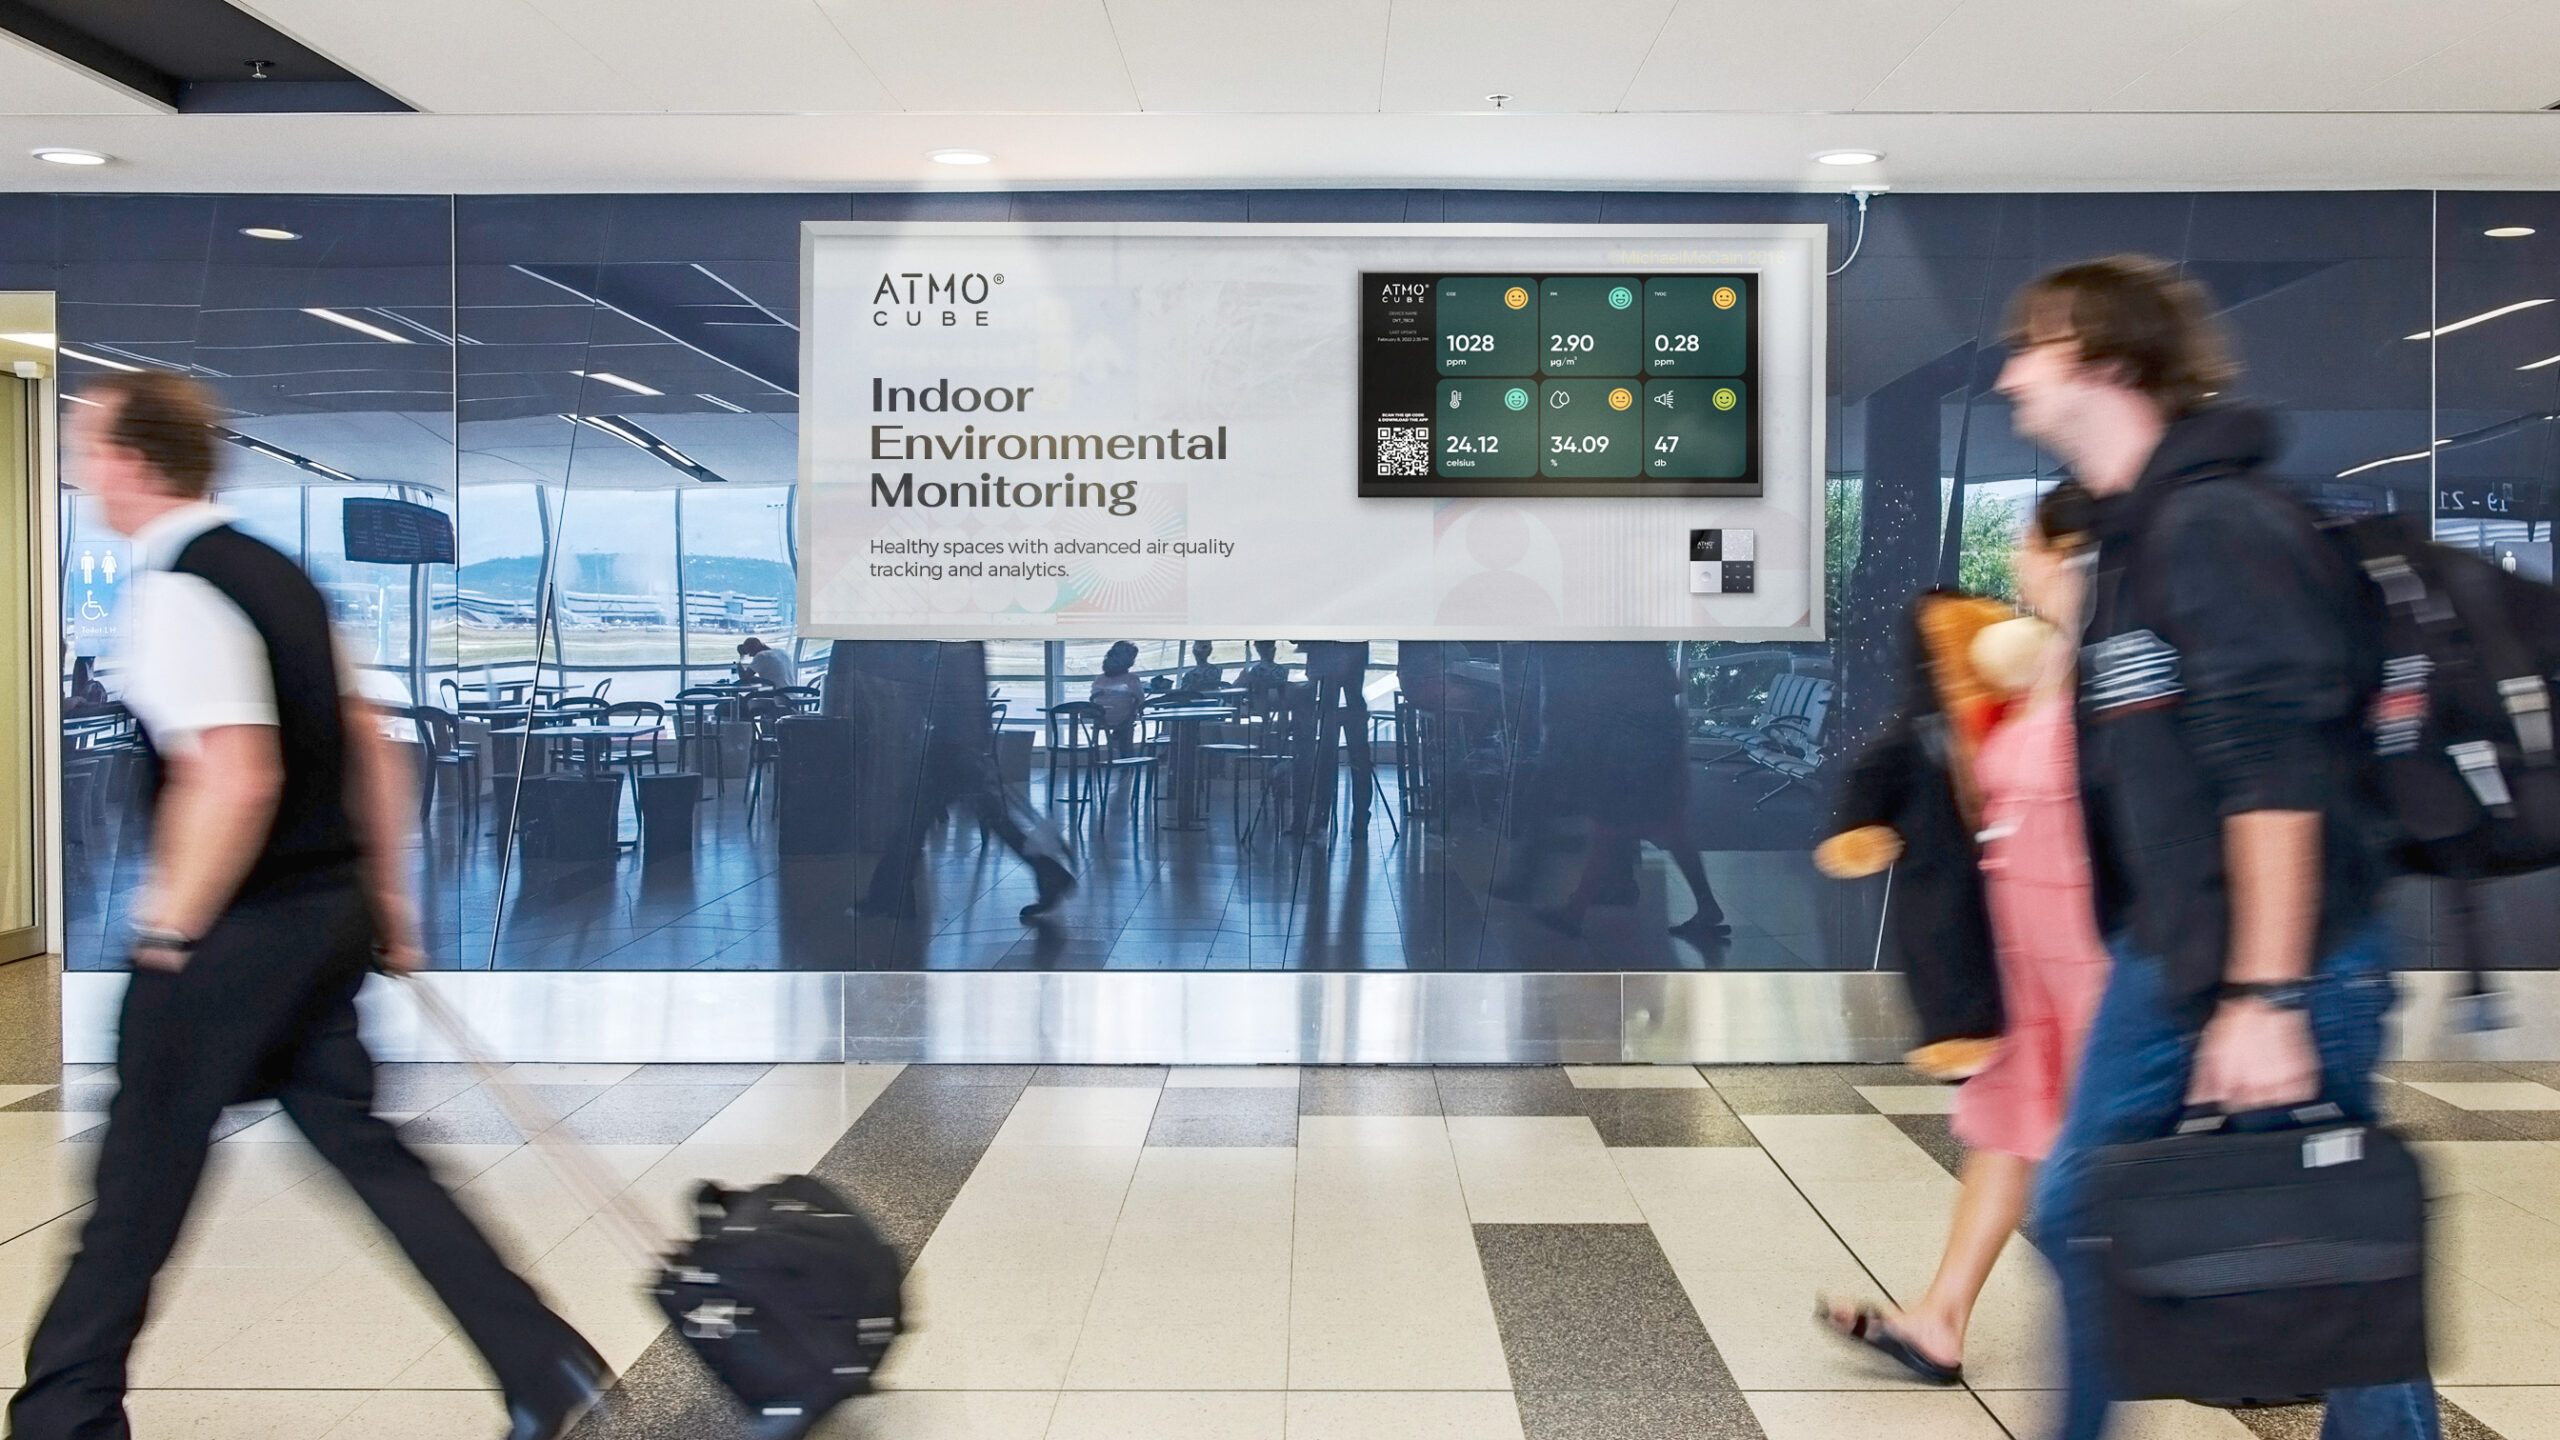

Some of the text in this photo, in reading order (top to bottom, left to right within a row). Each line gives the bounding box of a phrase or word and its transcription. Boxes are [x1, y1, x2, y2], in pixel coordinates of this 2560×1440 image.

[873, 311, 989, 326] CUBE
[1446, 334, 1495, 352] 1028
[1550, 334, 1594, 352] 2.90
[1655, 334, 1700, 352] 0.28
[1446, 359, 1467, 367] ppm
[1654, 359, 1675, 367] ppm
[873, 378, 1034, 412] Indoor
[872, 425, 1227, 460] Environmental
[1446, 435, 1499, 453] 24.12
[1550, 435, 1610, 453] 34.09
[1655, 435, 1680, 453] 47
[1446, 458, 1476, 467] celsius
[1550, 459, 1558, 467] %
[1654, 458, 1667, 467] db
[872, 473, 1138, 516] Monitoring
[870, 538, 1235, 558] Healthy spaces with advanced air quality
[870, 561, 1070, 581] tracking and analytics.
